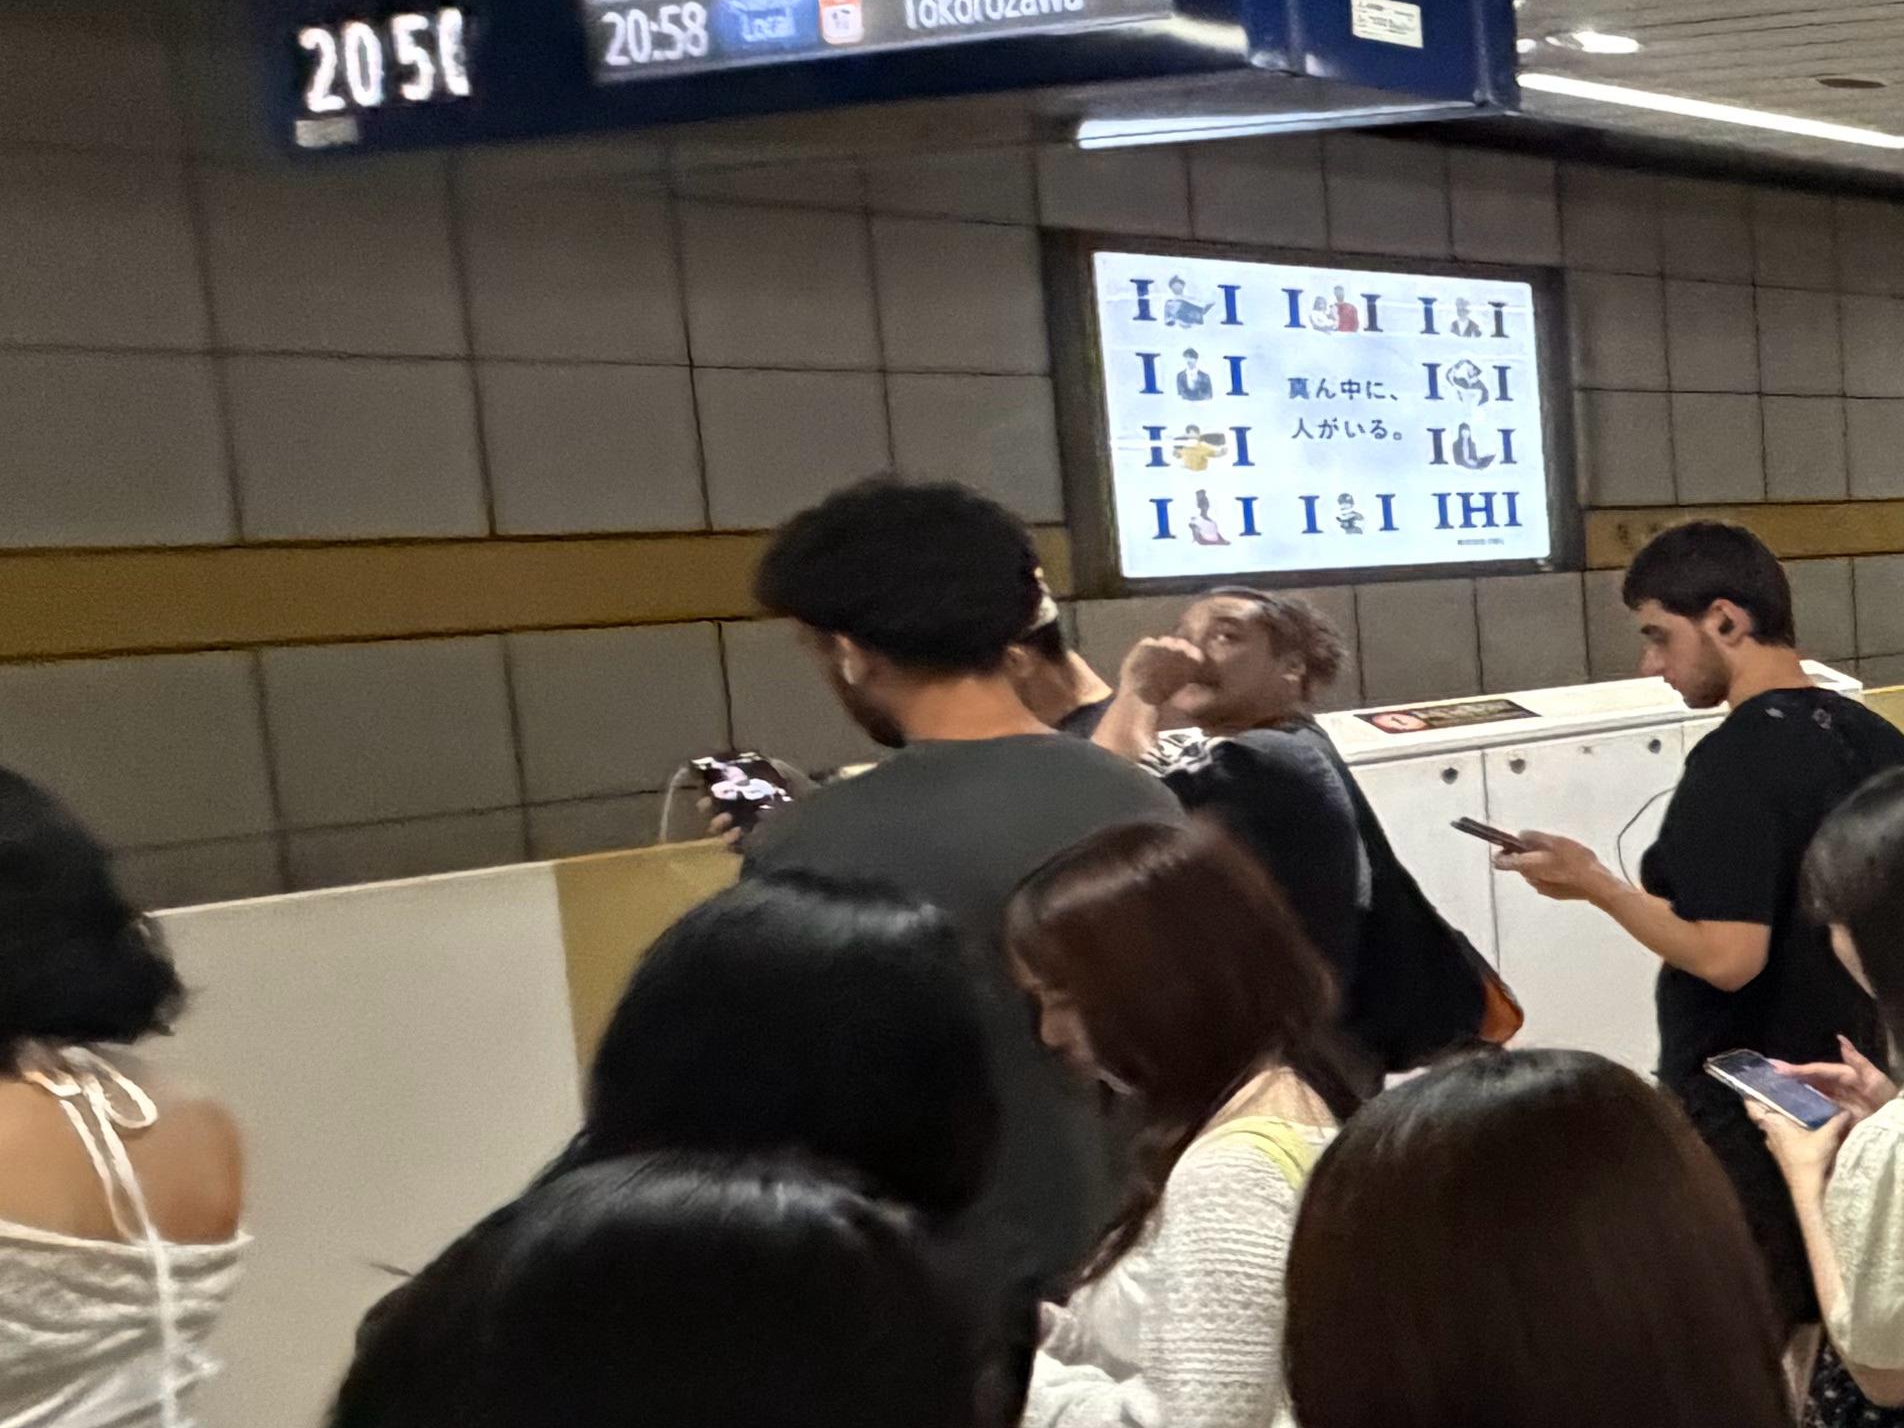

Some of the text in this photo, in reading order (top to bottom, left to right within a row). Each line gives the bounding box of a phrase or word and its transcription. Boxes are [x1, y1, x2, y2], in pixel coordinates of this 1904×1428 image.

[602, 1, 708, 65] 20:58
[1291, 417, 1402, 441] 人がいる。
[1431, 491, 1523, 529] IHI
